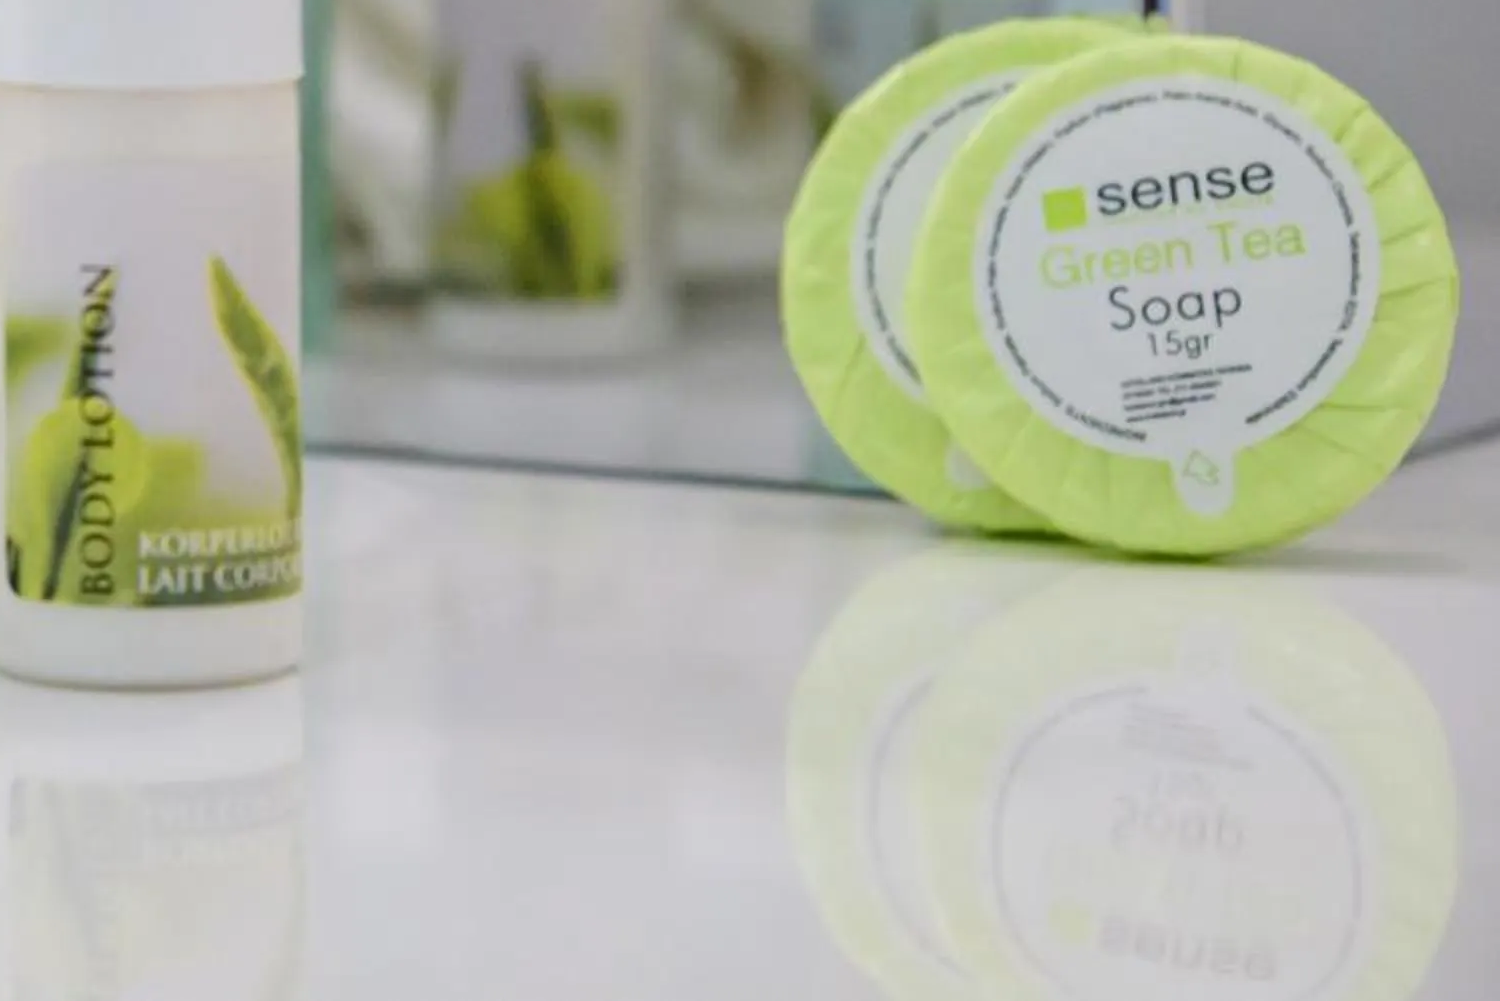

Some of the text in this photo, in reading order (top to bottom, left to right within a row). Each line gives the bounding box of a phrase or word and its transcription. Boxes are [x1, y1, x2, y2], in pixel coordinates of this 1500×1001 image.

[1096, 160, 1275, 216] sense
[1040, 219, 1307, 290] Green Tea
[1108, 284, 1242, 331] Soap
[1147, 330, 1213, 360] 15gr
[78, 263, 115, 596] BODY LOTION
[138, 562, 211, 596] LAIT
